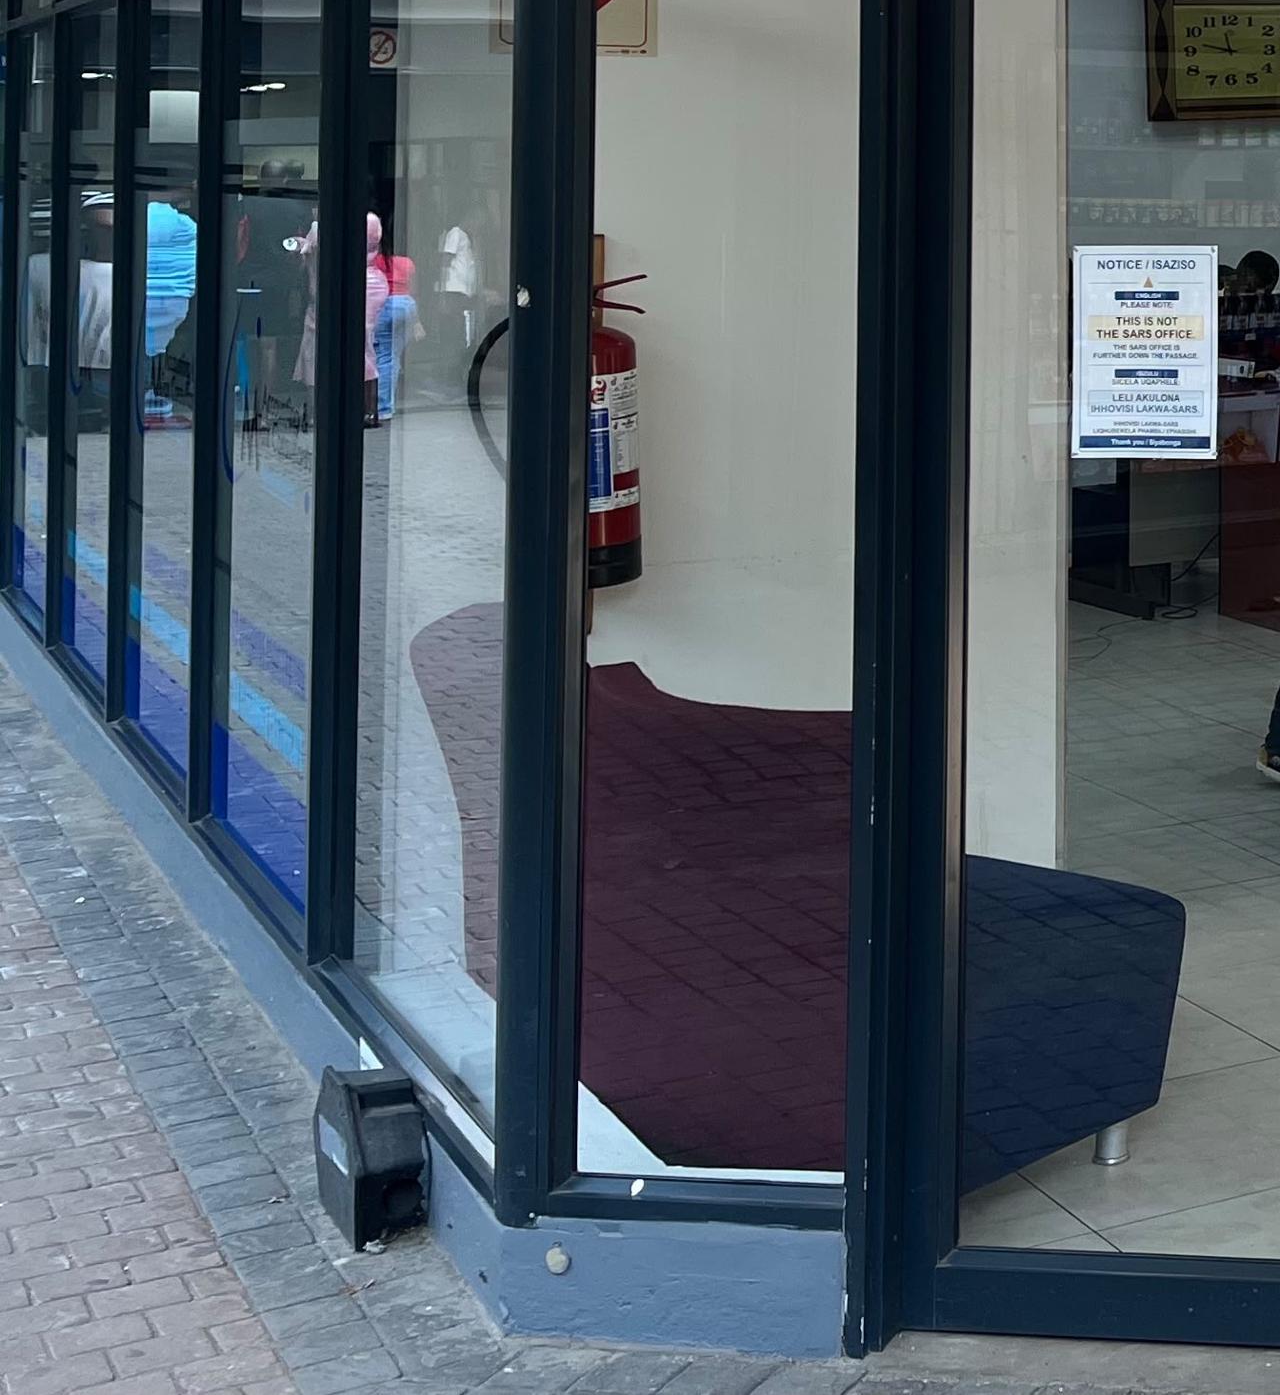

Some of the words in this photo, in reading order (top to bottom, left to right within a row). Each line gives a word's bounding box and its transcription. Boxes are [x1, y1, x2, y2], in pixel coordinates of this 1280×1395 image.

[1203, 16, 1216, 28] 11
[1221, 14, 1239, 26] 12
[1185, 26, 1202, 38] 10
[1261, 25, 1275, 36] 2
[1183, 45, 1197, 57] 9
[1263, 44, 1276, 56] 3
[1186, 65, 1200, 77] 8
[1261, 63, 1273, 74] 4
[1206, 74, 1218, 86] 7
[1224, 74, 1238, 86] 6
[1246, 73, 1259, 85] 5
[1097, 260, 1143, 270] NOTICE
[1152, 260, 1196, 270] ISAZISO
[1116, 316, 1141, 326] THIS
[1144, 316, 1154, 326] IS
[1157, 316, 1178, 326] NOT
[1096, 329, 1119, 339] THE
[1122, 329, 1152, 339] SARS
[1112, 394, 1134, 402] LELI
[1135, 394, 1180, 402] AKULONA
[1091, 405, 1134, 413] IHHOVISI
